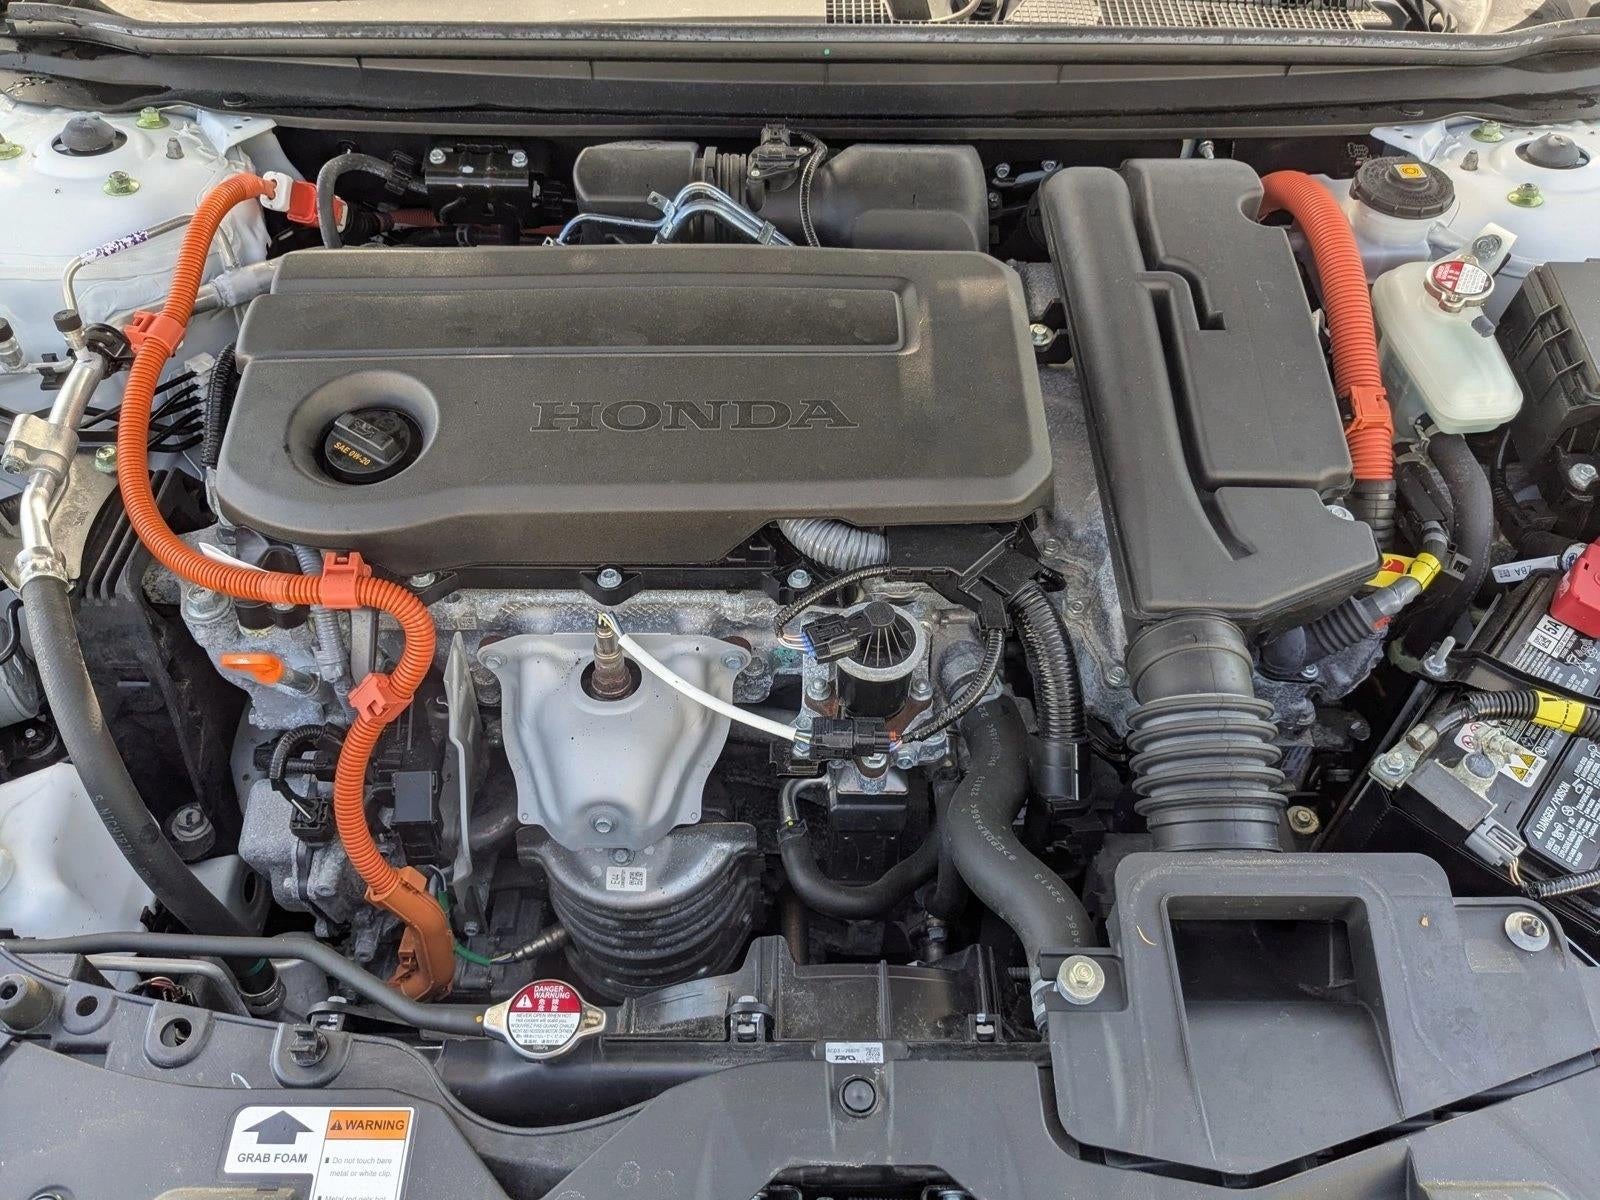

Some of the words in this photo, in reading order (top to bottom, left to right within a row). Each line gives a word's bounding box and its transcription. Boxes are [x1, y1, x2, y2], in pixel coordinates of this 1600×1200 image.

[530, 400, 859, 431] HONDA
[334, 442, 350, 454] SAE
[349, 450, 370, 466] 0W-20
[1544, 619, 1561, 635] 5A
[1535, 805, 1557, 832] DANGER
[1551, 780, 1571, 804] POISON
[345, 1120, 405, 1130] WARNING
[237, 1153, 270, 1163] GRAB
[274, 1153, 308, 1163] FOAM
